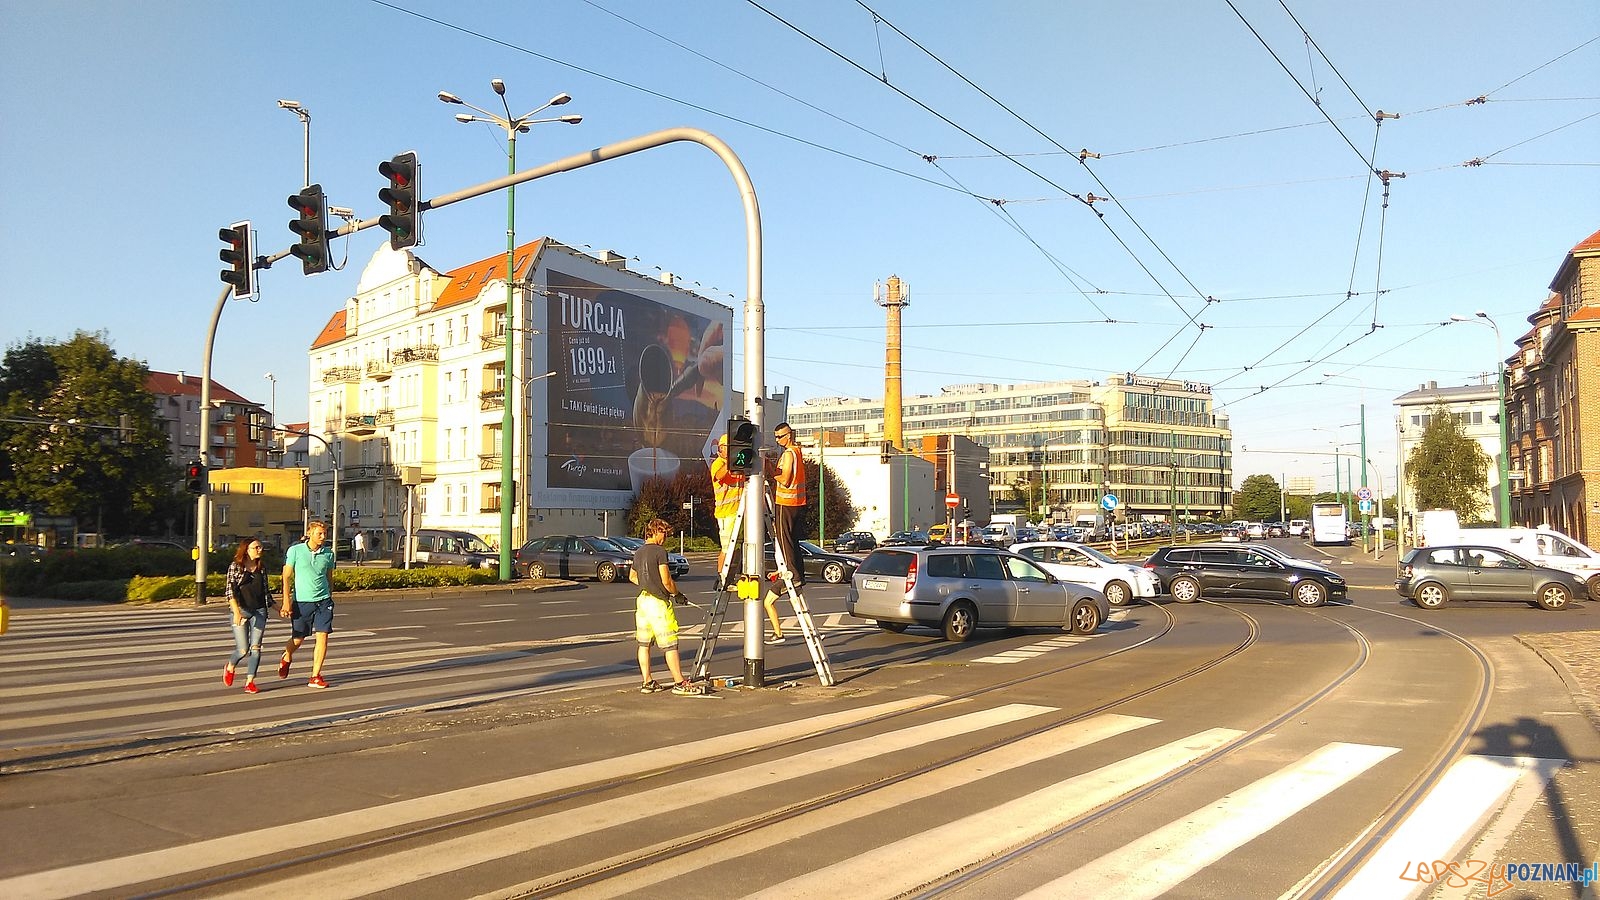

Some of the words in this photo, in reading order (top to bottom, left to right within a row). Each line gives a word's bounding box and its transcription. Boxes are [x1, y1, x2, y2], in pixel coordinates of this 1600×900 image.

[558, 291, 625, 340] TURCJA
[570, 347, 605, 376] 1899
[607, 356, 616, 374] zł
[569, 400, 583, 411] TAKI
[583, 402, 598, 414] świat
[598, 404, 608, 416] jest
[608, 406, 625, 419] piękny
